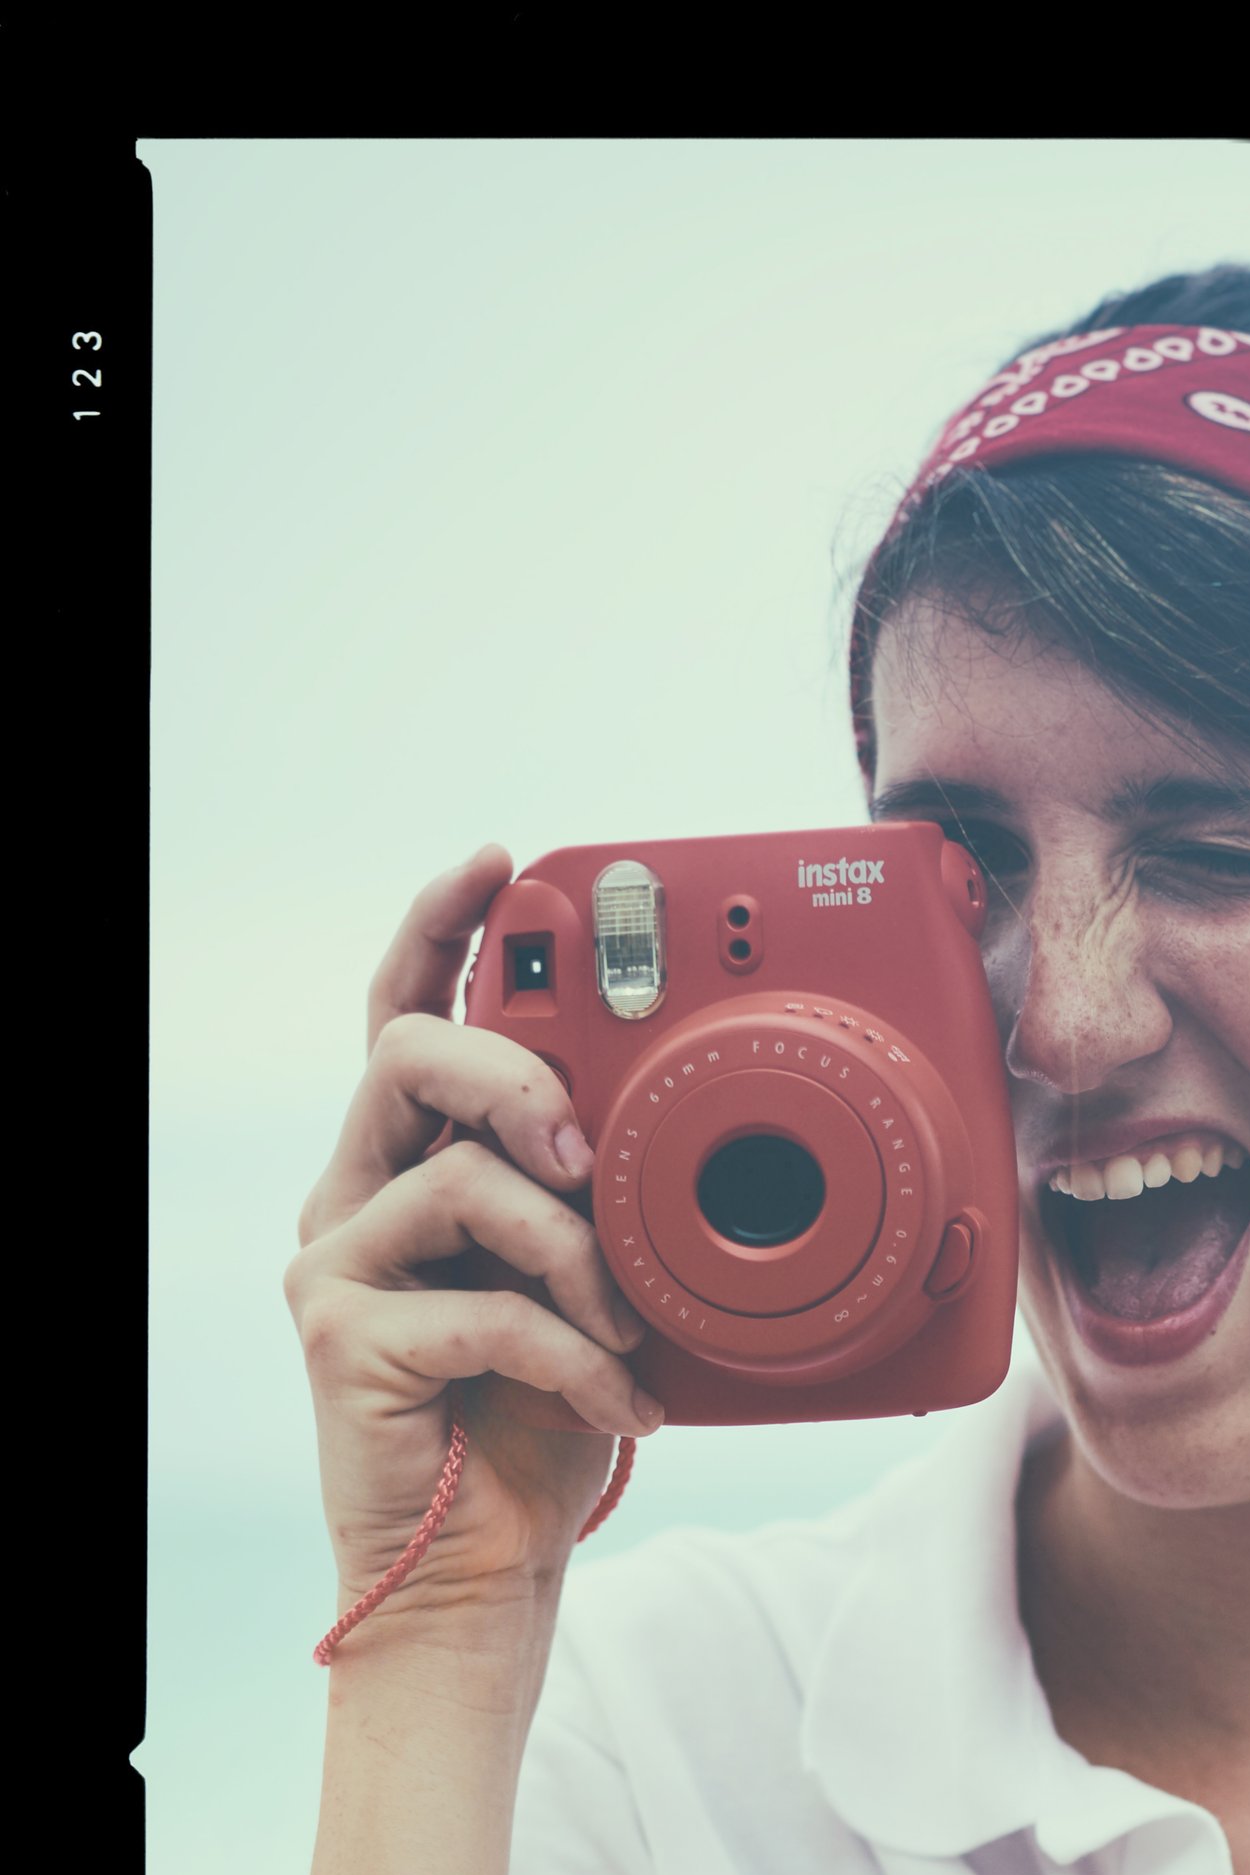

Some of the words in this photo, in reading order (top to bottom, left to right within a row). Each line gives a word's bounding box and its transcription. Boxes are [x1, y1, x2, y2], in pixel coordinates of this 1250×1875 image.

[798, 857, 885, 888] instax
[812, 887, 853, 907] mini
[856, 886, 872, 904] 8
[649, 1050, 720, 1103] 60mm
[752, 1040, 850, 1079] FOCUS
[614, 1128, 638, 1204] LENS
[870, 1097, 913, 1196] RANGE
[623, 1236, 707, 1330] INSTAX
